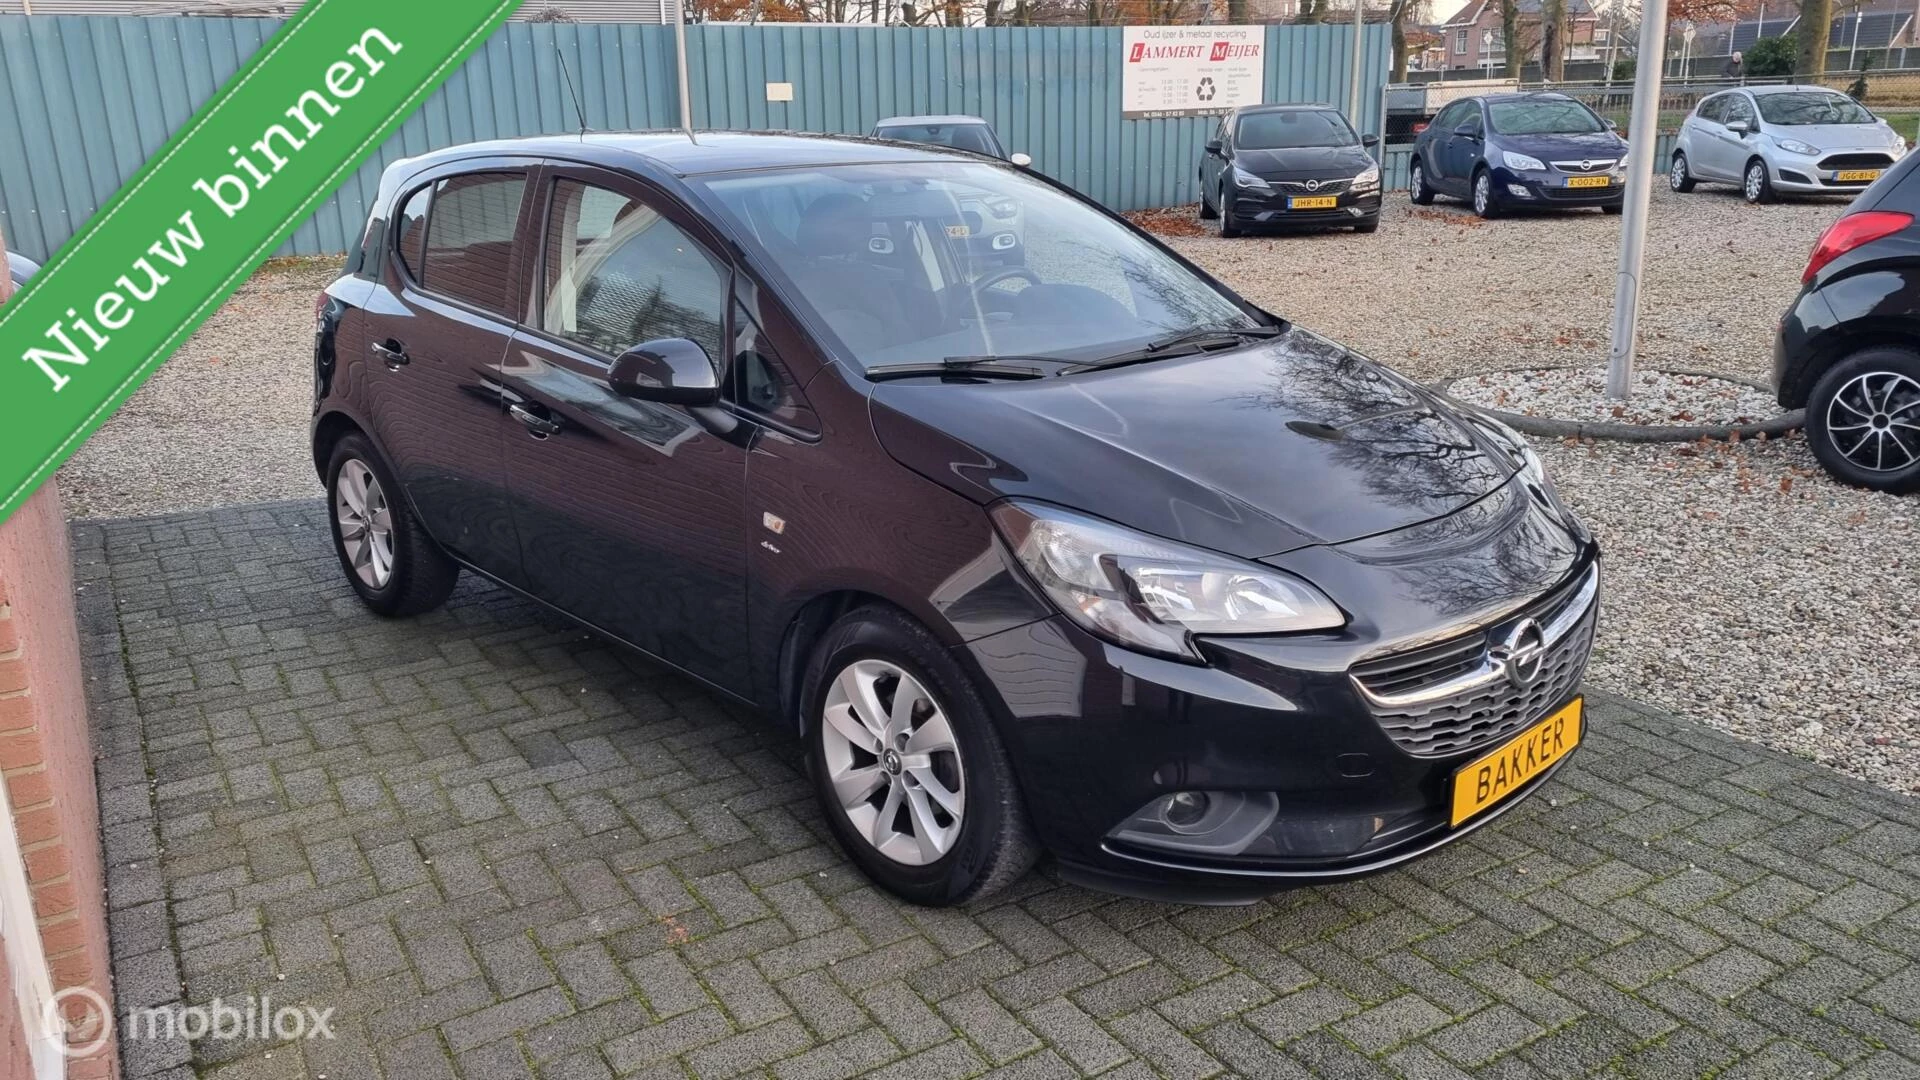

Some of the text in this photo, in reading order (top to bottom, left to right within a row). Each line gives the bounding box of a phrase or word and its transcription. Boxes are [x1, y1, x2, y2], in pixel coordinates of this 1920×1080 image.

[1143, 30, 1160, 39] Oud
[1179, 30, 1184, 39] &
[1186, 30, 1212, 39] metaal
[1213, 30, 1247, 39] recycling
[1130, 43, 1260, 61] LAMMERT MEIJER
[1295, 198, 1333, 207] JHR-14-N
[1476, 717, 1564, 804] BAKKER
